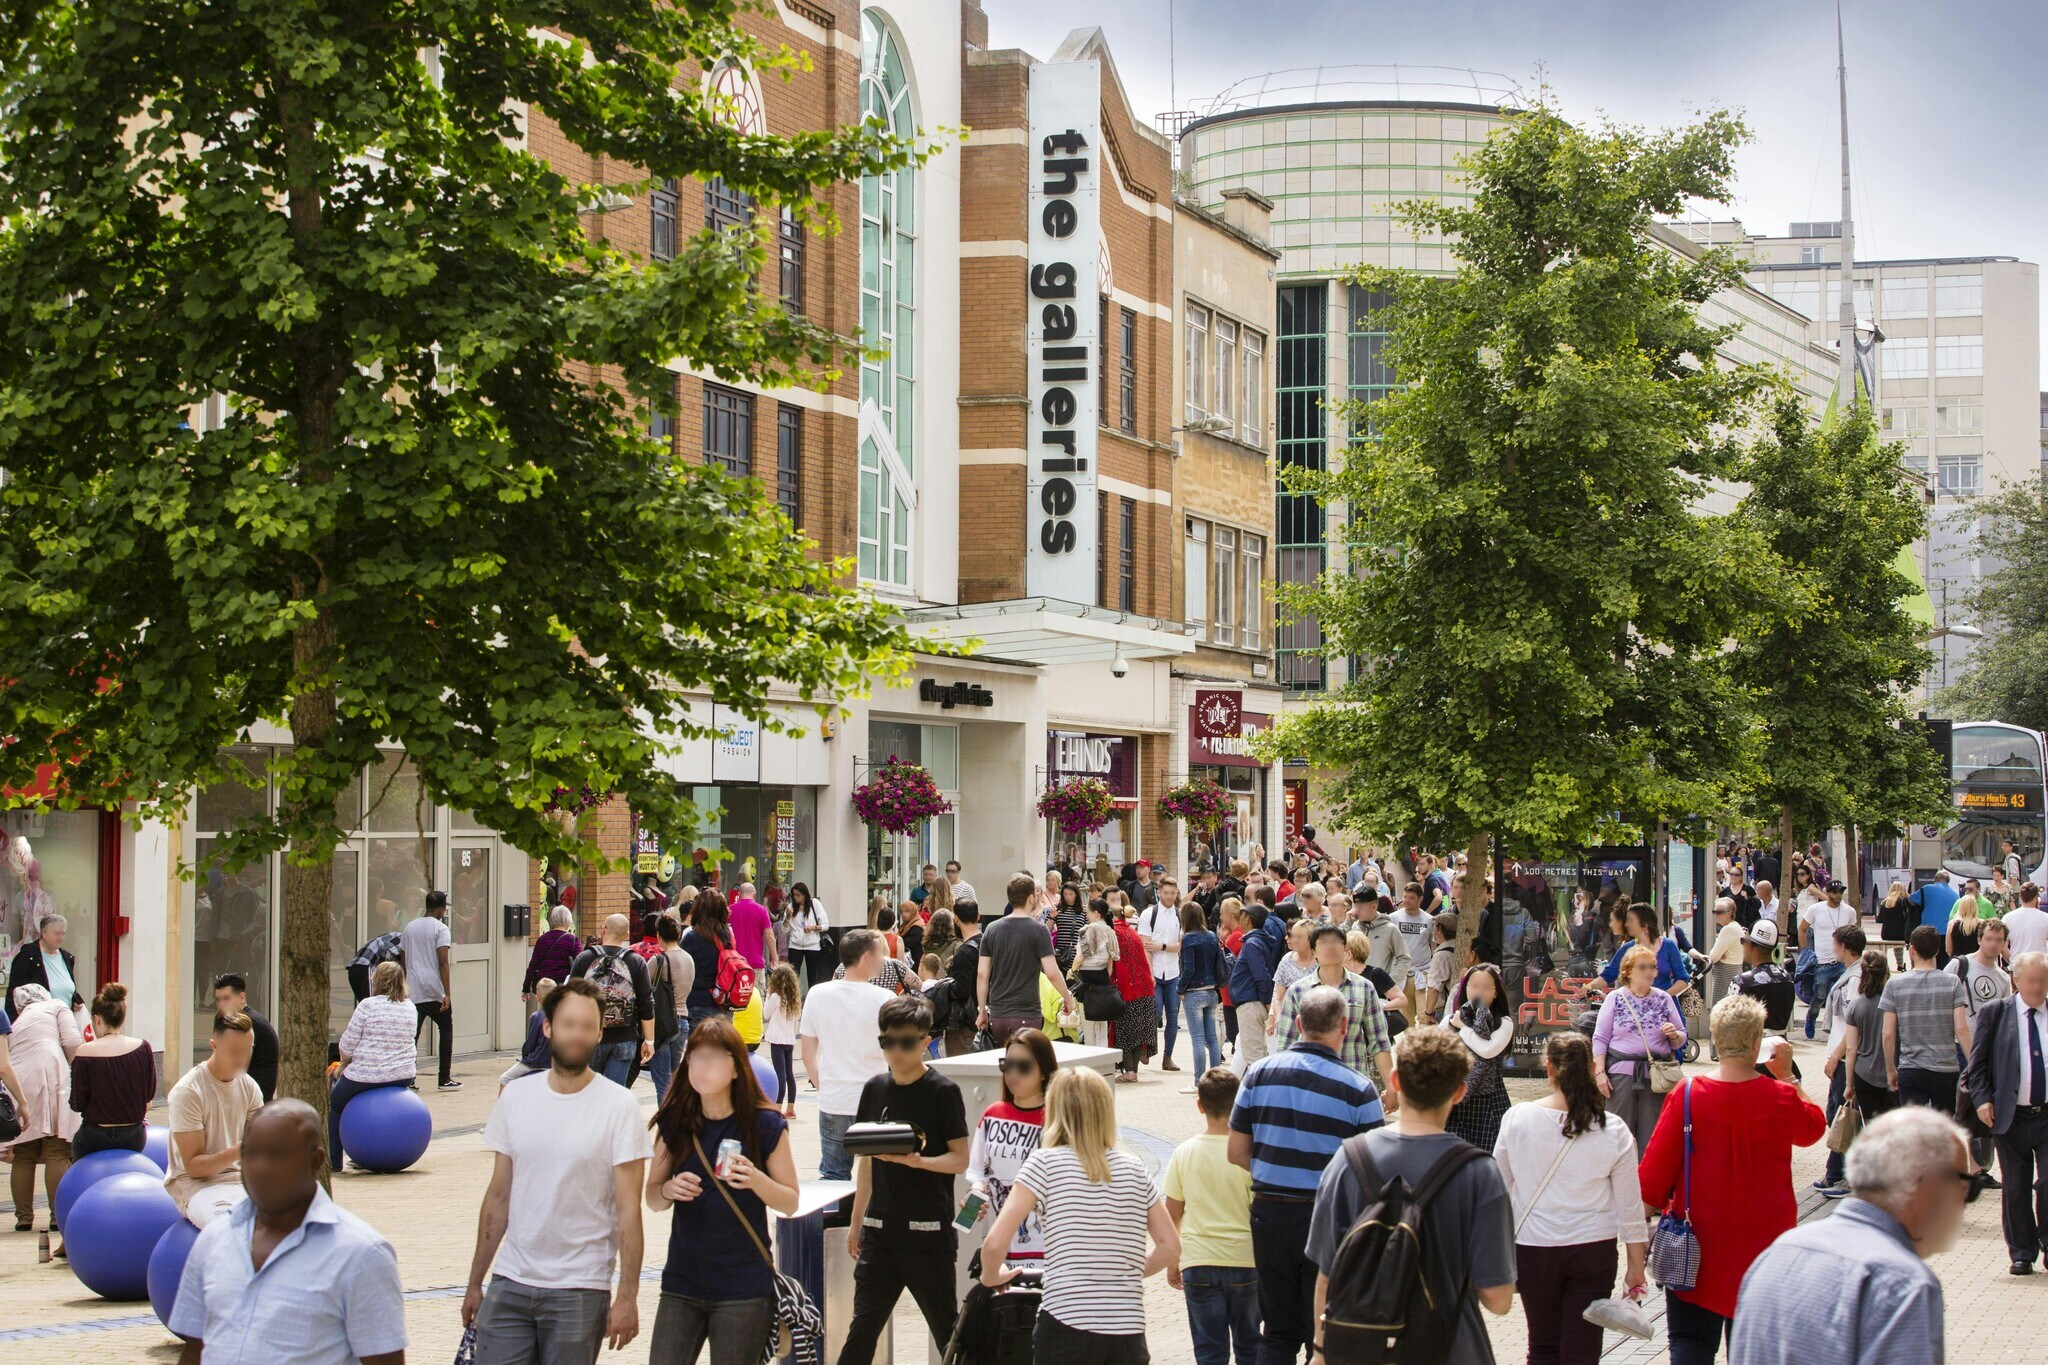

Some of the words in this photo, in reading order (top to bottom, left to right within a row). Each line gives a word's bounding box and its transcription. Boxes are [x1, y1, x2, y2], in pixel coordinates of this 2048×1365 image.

[1043, 128, 1090, 240] the
[1030, 260, 1089, 556] galleries
[920, 678, 946, 702] the
[941, 681, 994, 709] galleries
[1198, 693, 1220, 712] ORGANIC
[1221, 694, 1238, 713] COFFEE
[1207, 706, 1229, 722] PRET
[1199, 718, 1223, 735] NATURAL
[1223, 719, 1237, 733] FOOD
[722, 746, 751, 756] FASHION
[1957, 793, 1985, 803] Cadbury
[1986, 794, 2007, 803] Heath
[2010, 793, 2025, 808] 43
[777, 817, 795, 829] SALE
[638, 828, 659, 841] SAE
[777, 829, 795, 841] SALE
[638, 840, 659, 853] SALE
[777, 841, 795, 852] SALE
[461, 850, 471, 867] 85
[1524, 867, 1540, 876] 100
[1545, 867, 1577, 876] METRES
[1582, 868, 1603, 877] THIS
[1608, 869, 1624, 877] WAY
